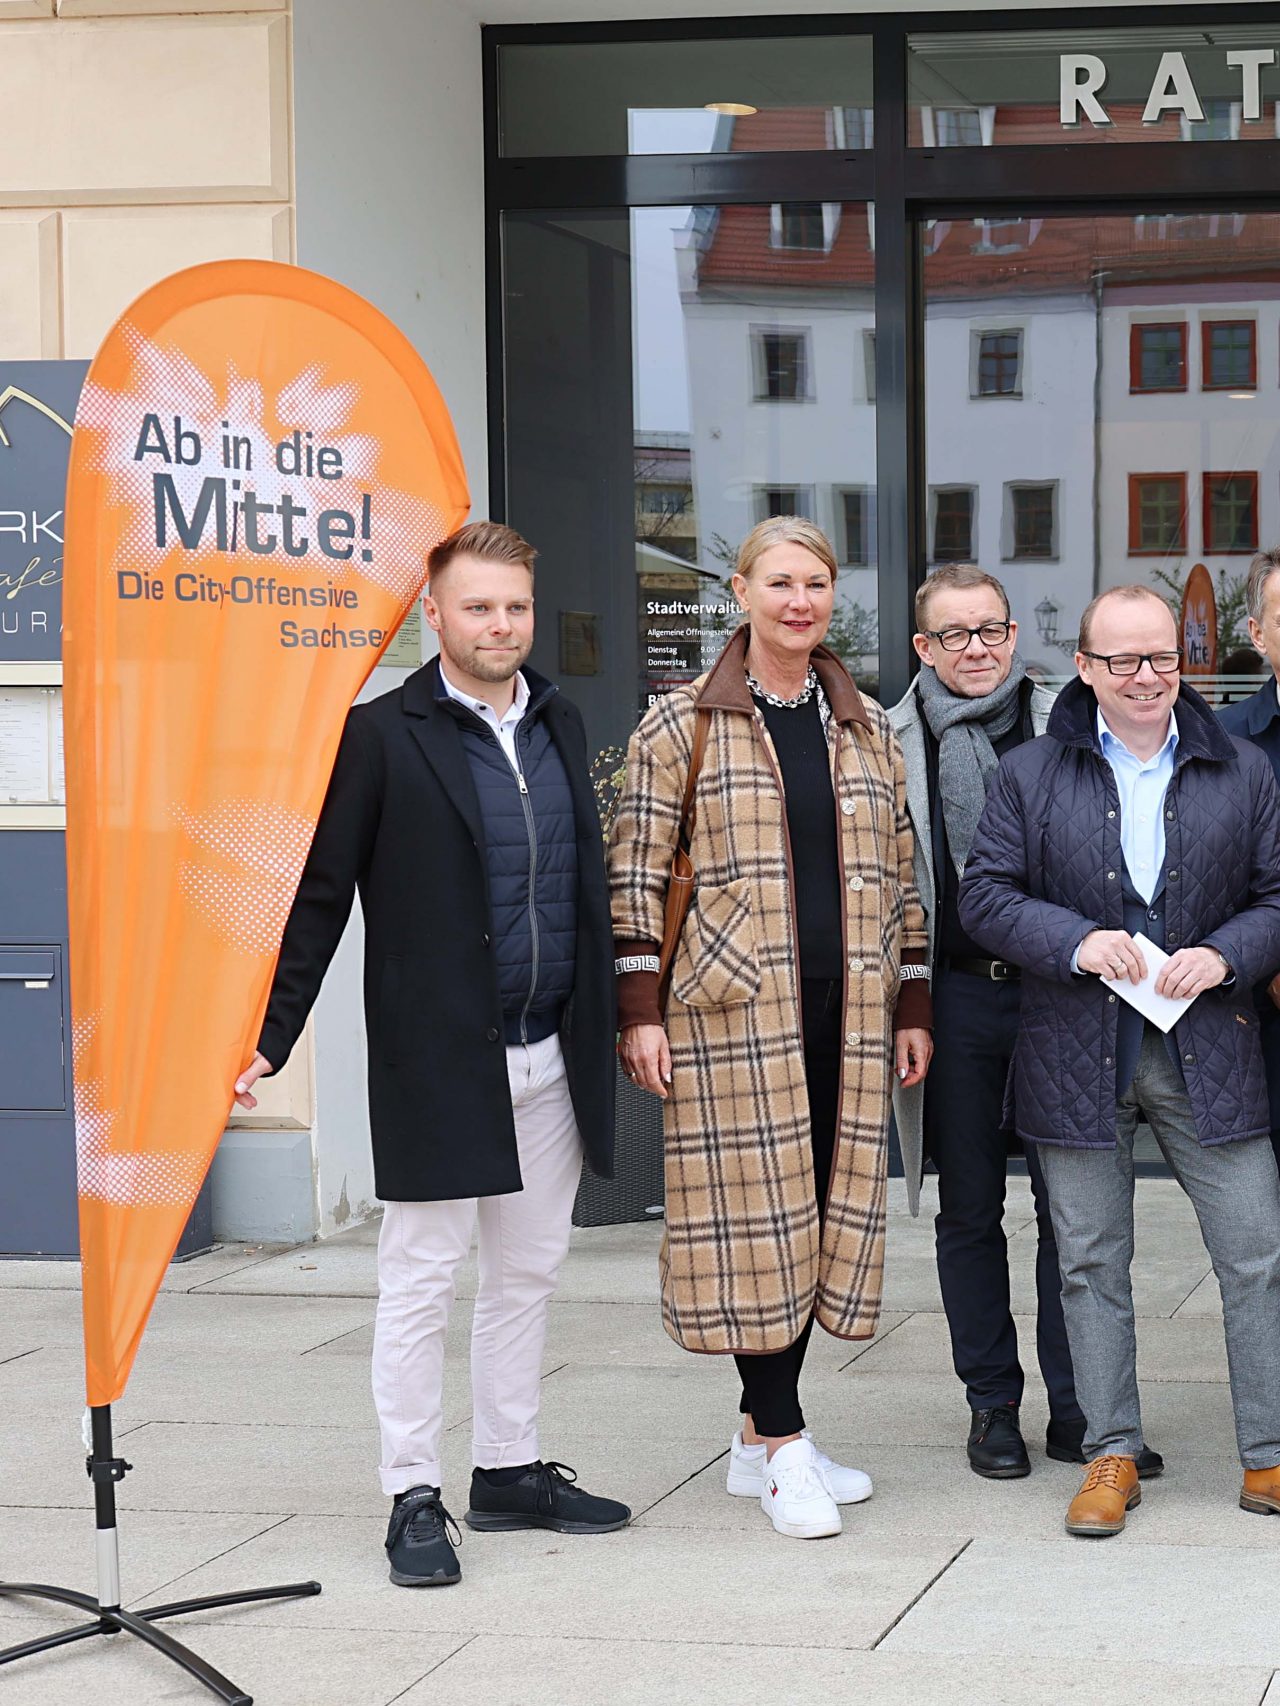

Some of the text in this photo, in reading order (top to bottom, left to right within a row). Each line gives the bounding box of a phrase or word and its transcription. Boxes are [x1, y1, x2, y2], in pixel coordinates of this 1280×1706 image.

[133, 413, 344, 480] Ab in die
[152, 472, 374, 563] Mitte!
[116, 570, 359, 610] Die City-Offensive
[2, 610, 64, 633] UR
[647, 629, 684, 638] Allgemeine
[647, 646, 678, 655] Dienstag
[647, 658, 716, 667] Donnerstag 9.00
